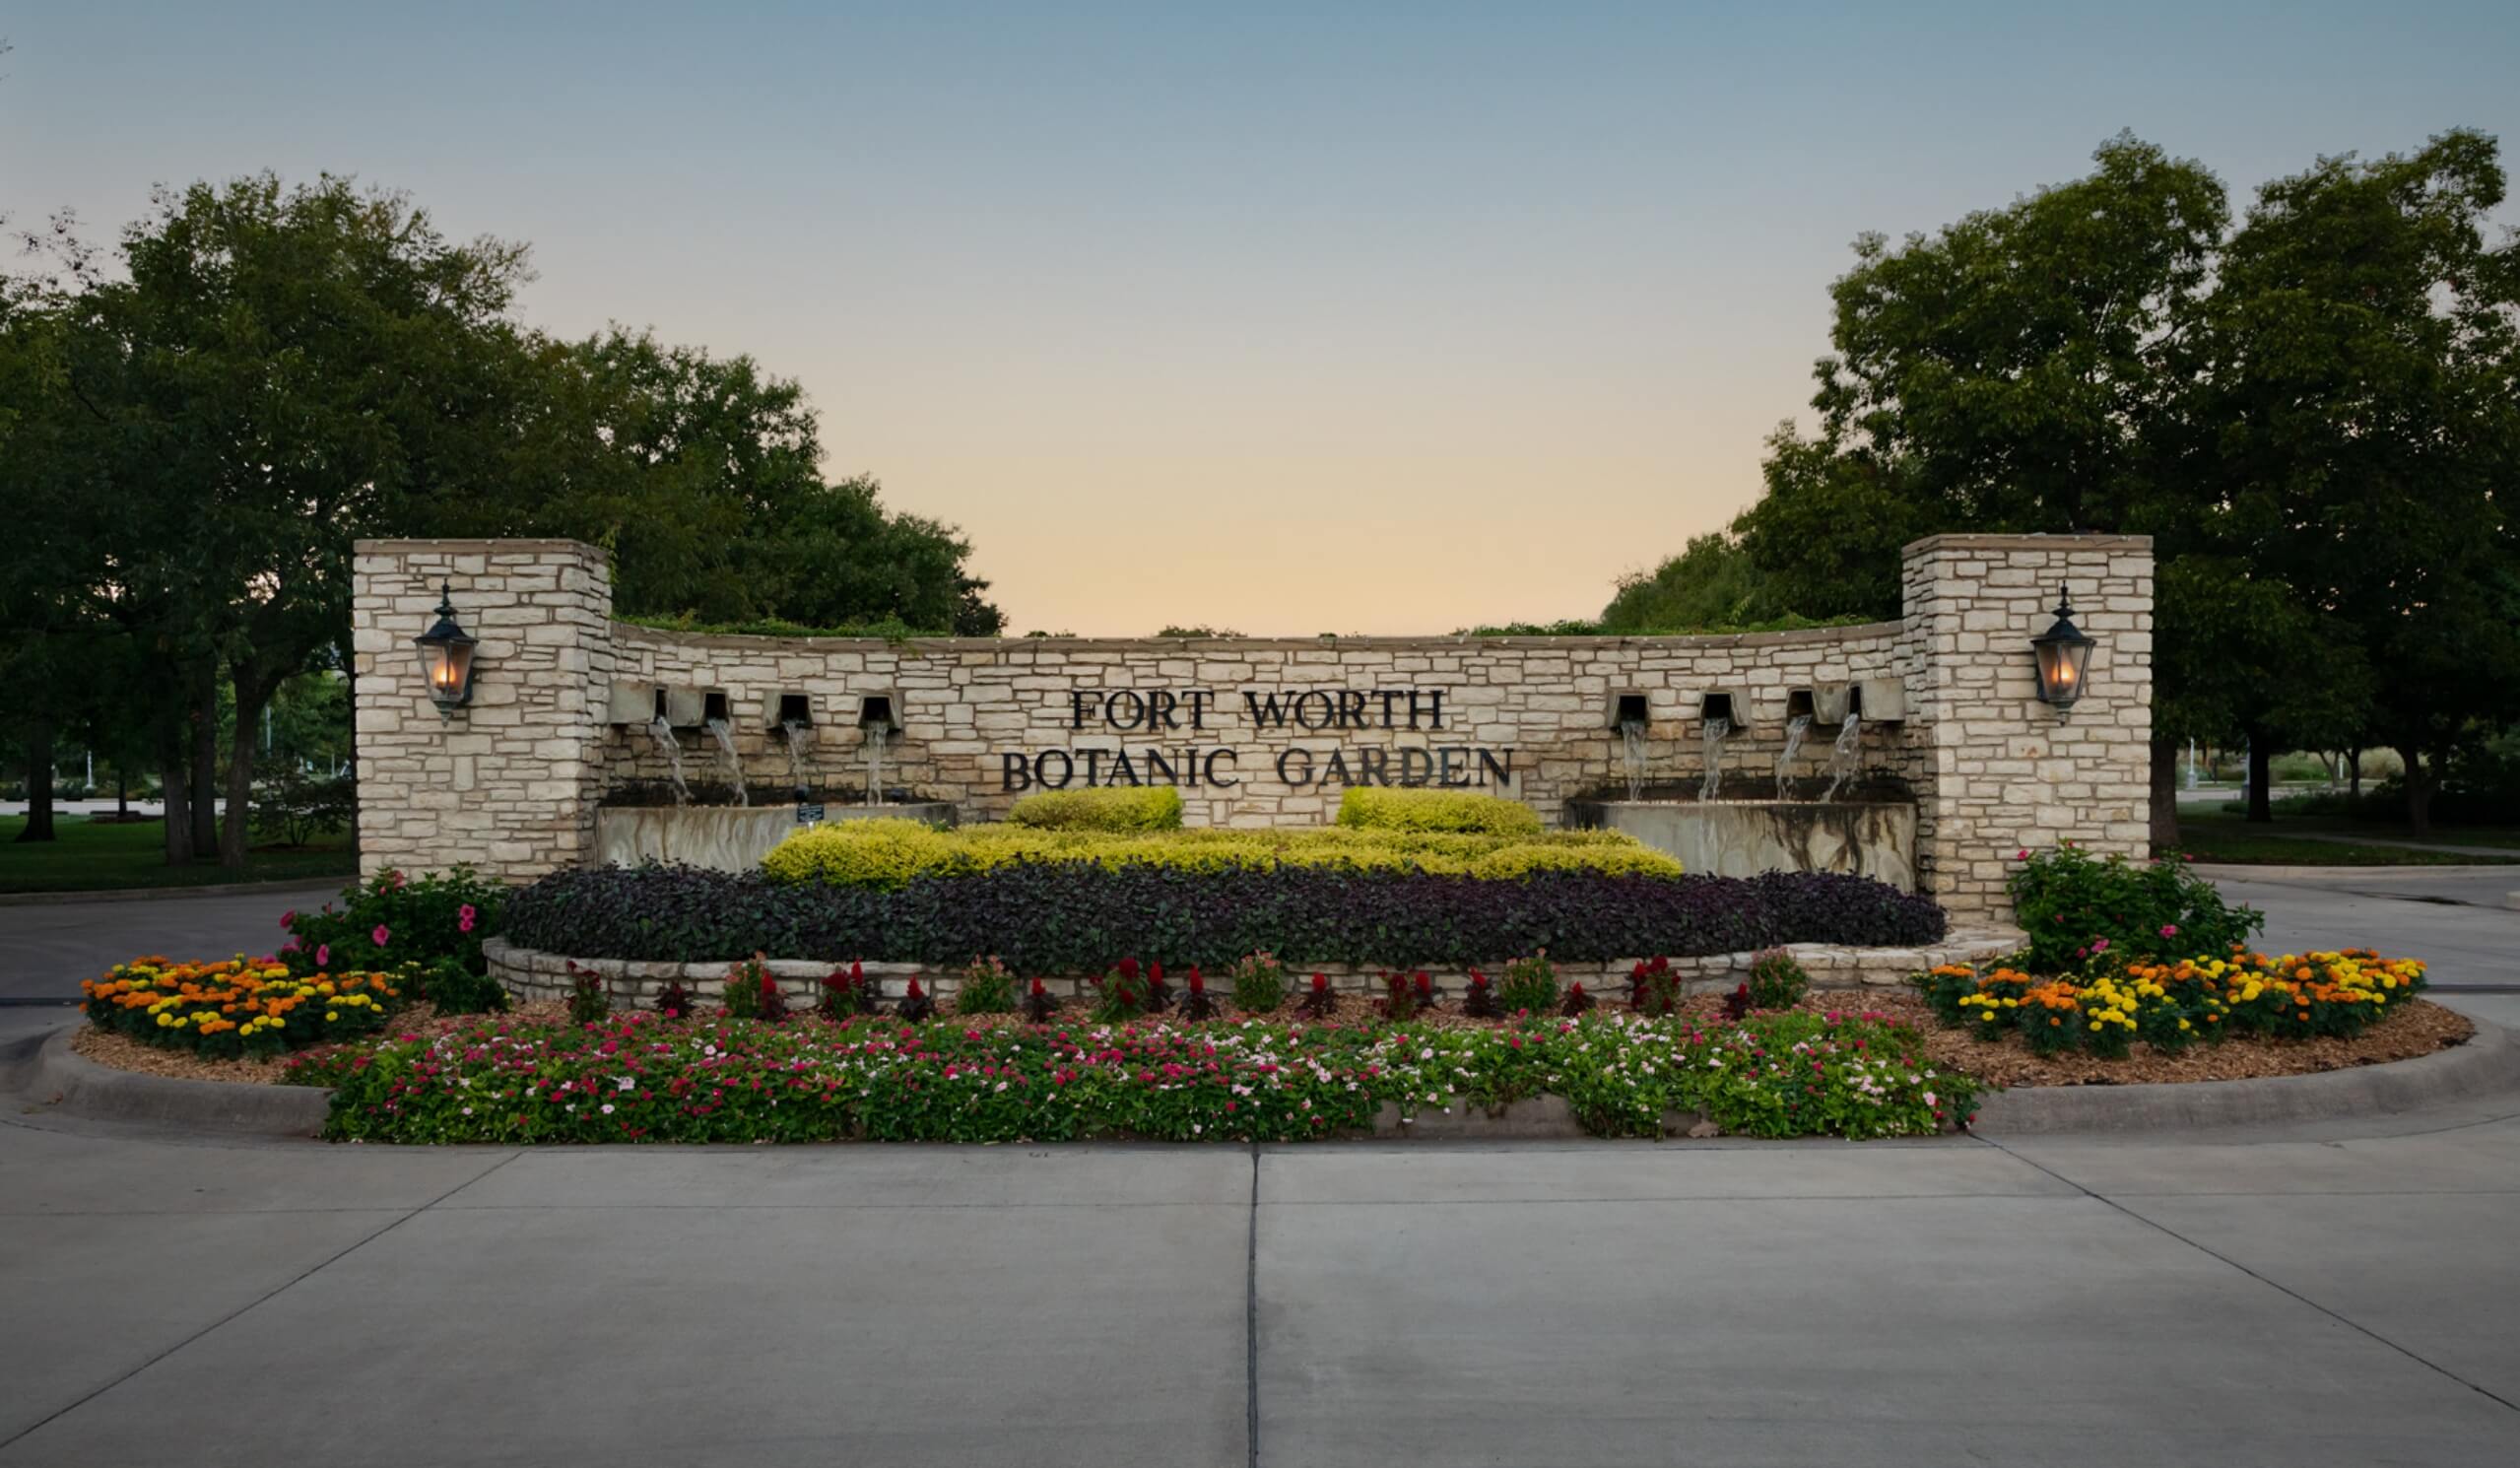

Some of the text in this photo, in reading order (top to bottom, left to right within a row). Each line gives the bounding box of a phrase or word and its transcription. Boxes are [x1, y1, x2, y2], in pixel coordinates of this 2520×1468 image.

[1071, 690, 1444, 730] FORT WORTH
[1001, 747, 1514, 792] BOTANIC GARDEN
